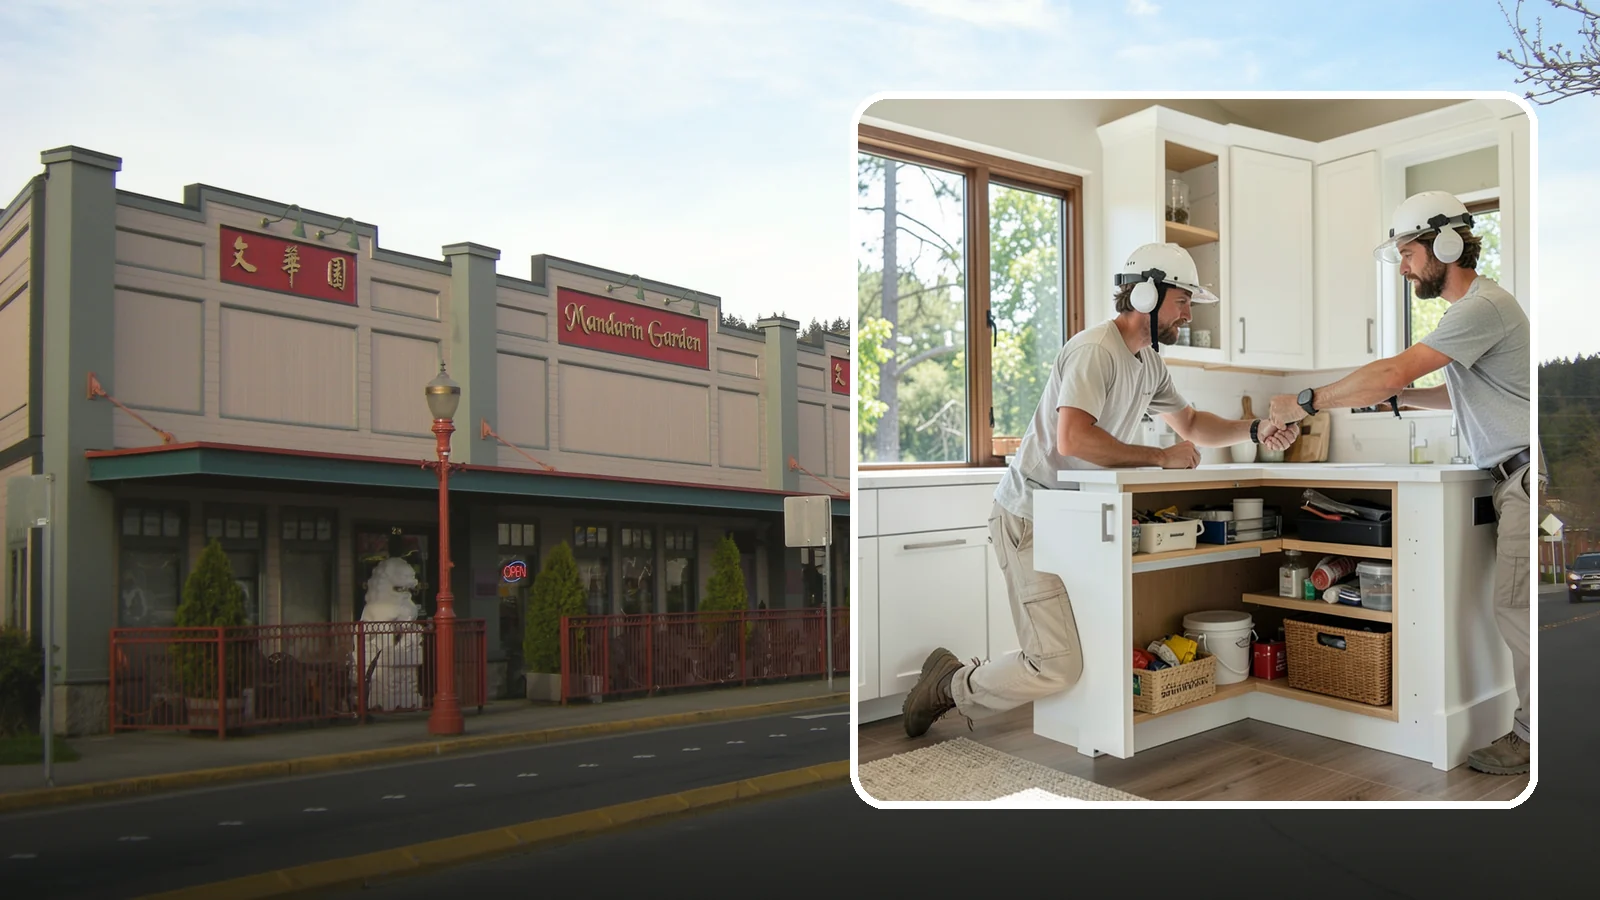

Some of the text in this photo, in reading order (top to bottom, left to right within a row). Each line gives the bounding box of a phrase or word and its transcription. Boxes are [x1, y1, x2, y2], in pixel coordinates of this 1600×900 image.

[231, 236, 346, 291] 文華園
[564, 302, 702, 352] Mandarin Garden
[503, 565, 527, 578] OPEN
